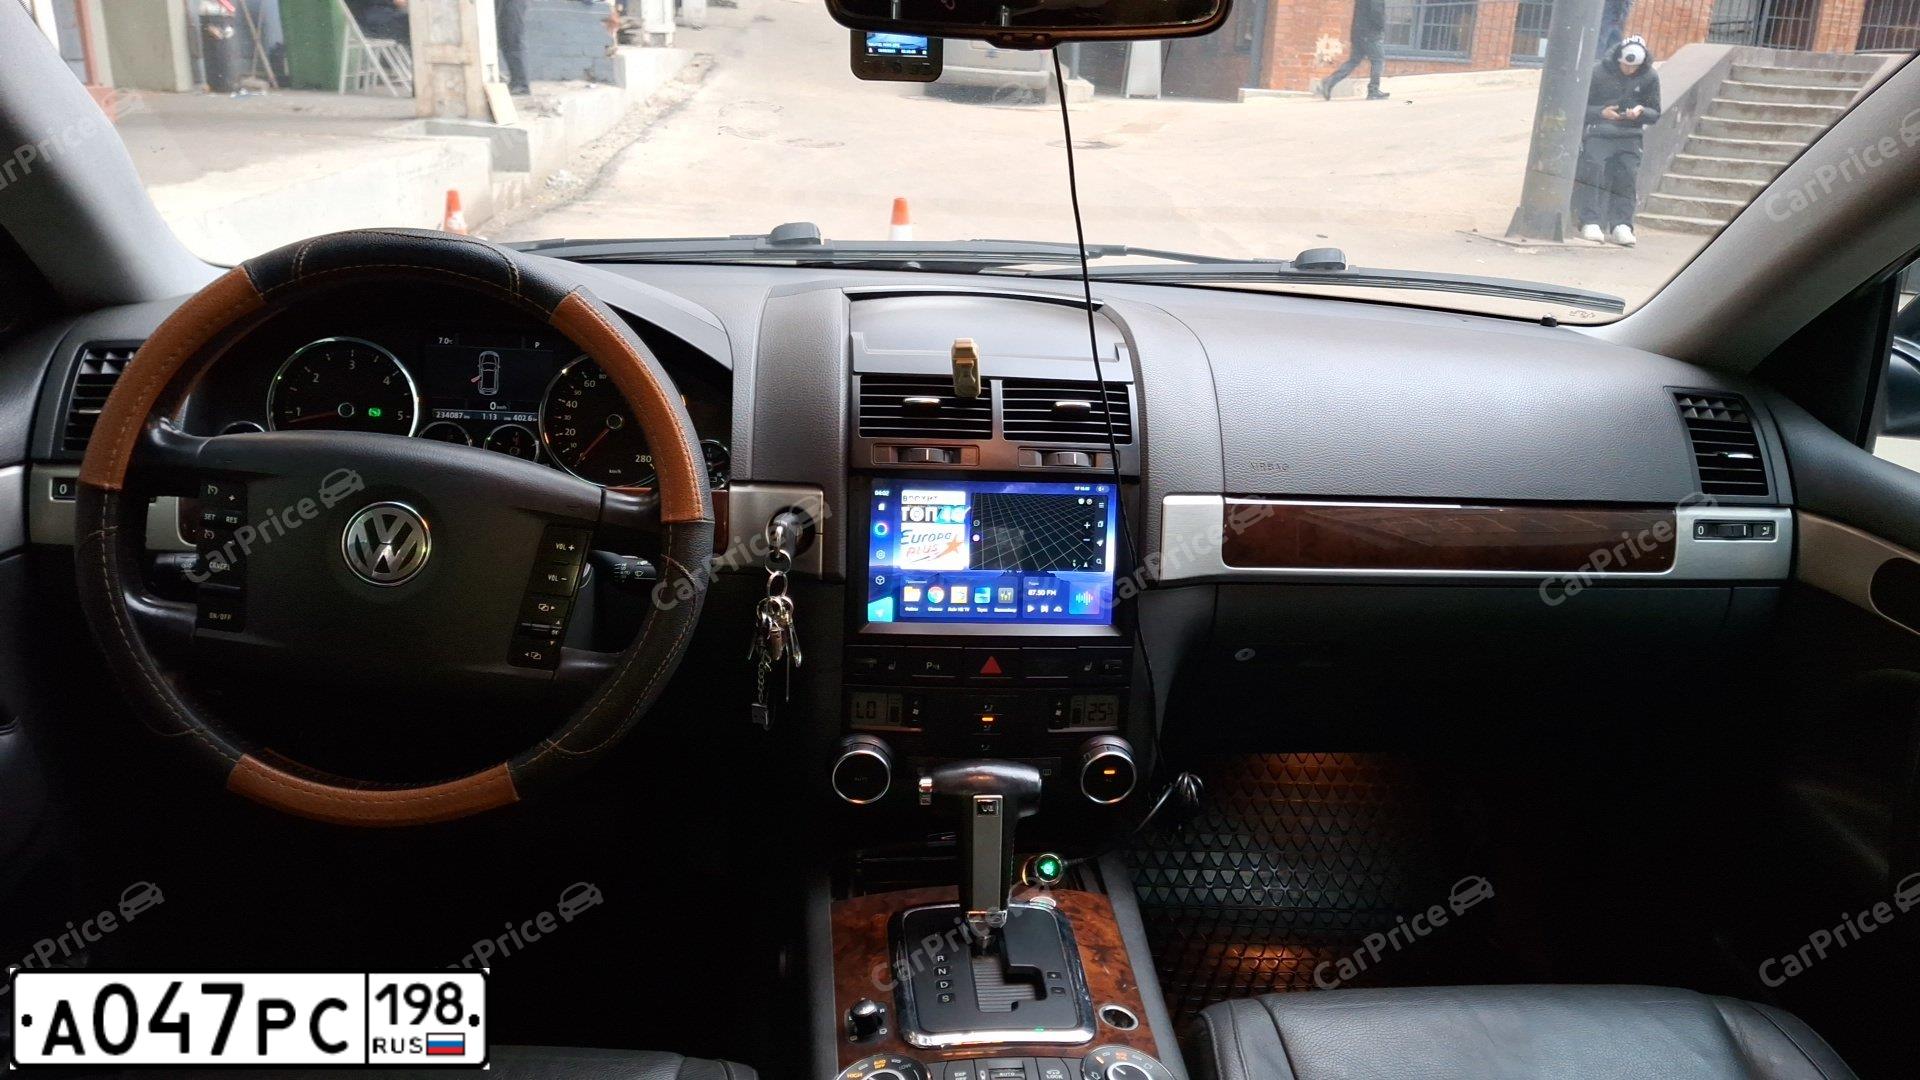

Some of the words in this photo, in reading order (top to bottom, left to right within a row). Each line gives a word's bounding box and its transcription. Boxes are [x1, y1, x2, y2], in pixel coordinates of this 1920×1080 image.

[534, 341, 540, 349] P
[349, 360, 356, 370] 3
[312, 372, 320, 384] 2
[382, 375, 391, 386] 4
[583, 379, 596, 388] 60
[489, 402, 497, 411] 0
[565, 400, 578, 409] 40
[397, 410, 405, 420] 5
[564, 428, 577, 436] 20
[635, 454, 653, 463] 280
[58, 483, 68, 495] 0
[204, 513, 217, 521] SET
[226, 516, 239, 524] RES
[1697, 525, 1705, 535] 0
[555, 543, 567, 551] VOL
[548, 574, 559, 582] VOL
[940, 981, 949, 989] D
